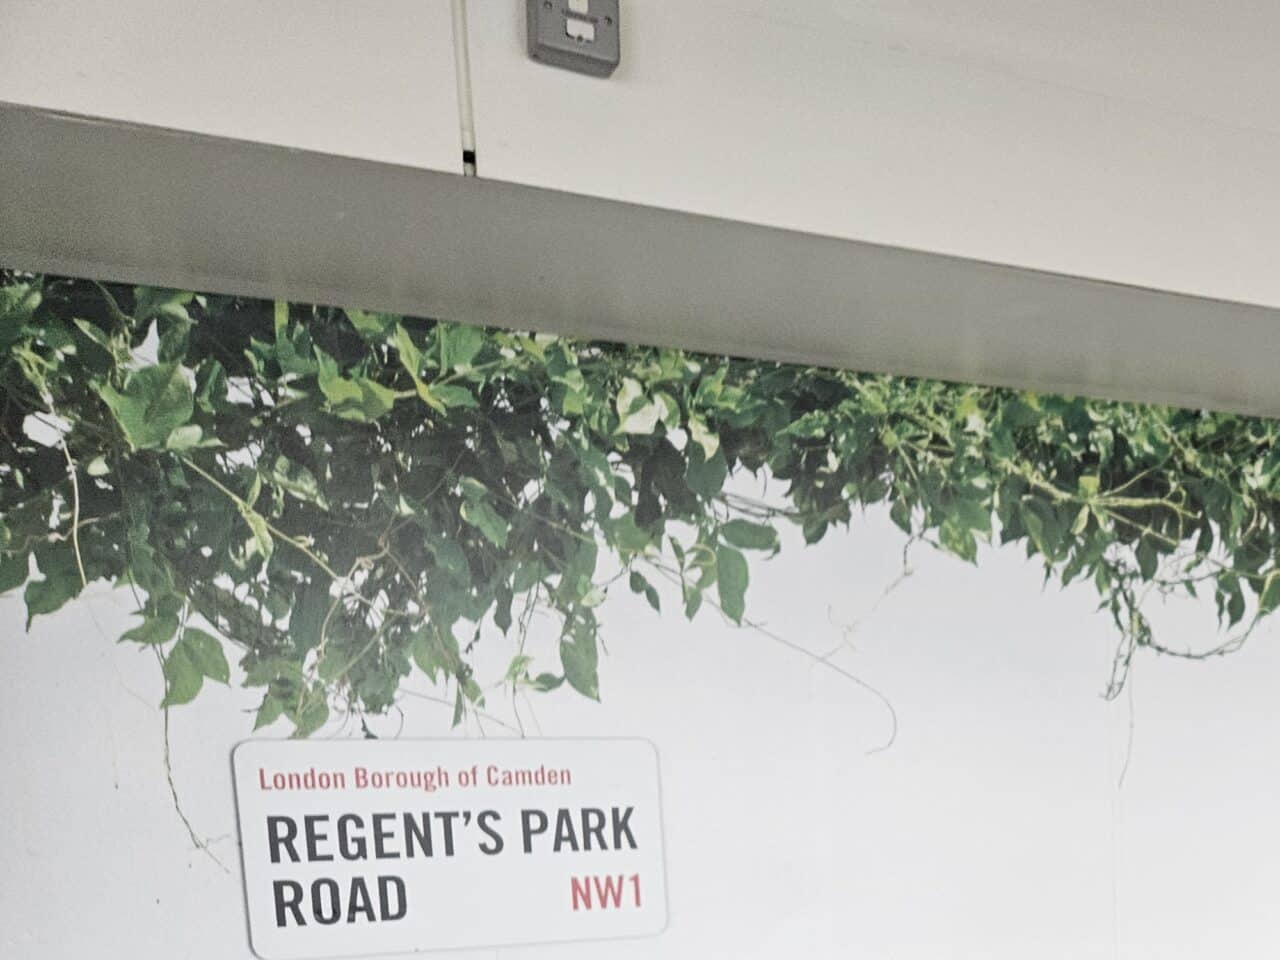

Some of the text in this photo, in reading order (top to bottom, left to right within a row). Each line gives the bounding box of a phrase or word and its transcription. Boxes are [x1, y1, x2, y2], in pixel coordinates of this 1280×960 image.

[259, 765, 572, 792] London Borough of Camden
[266, 806, 639, 864] REGENT'S PARK
[272, 875, 408, 928] ROAD
[570, 873, 643, 911] NW1
